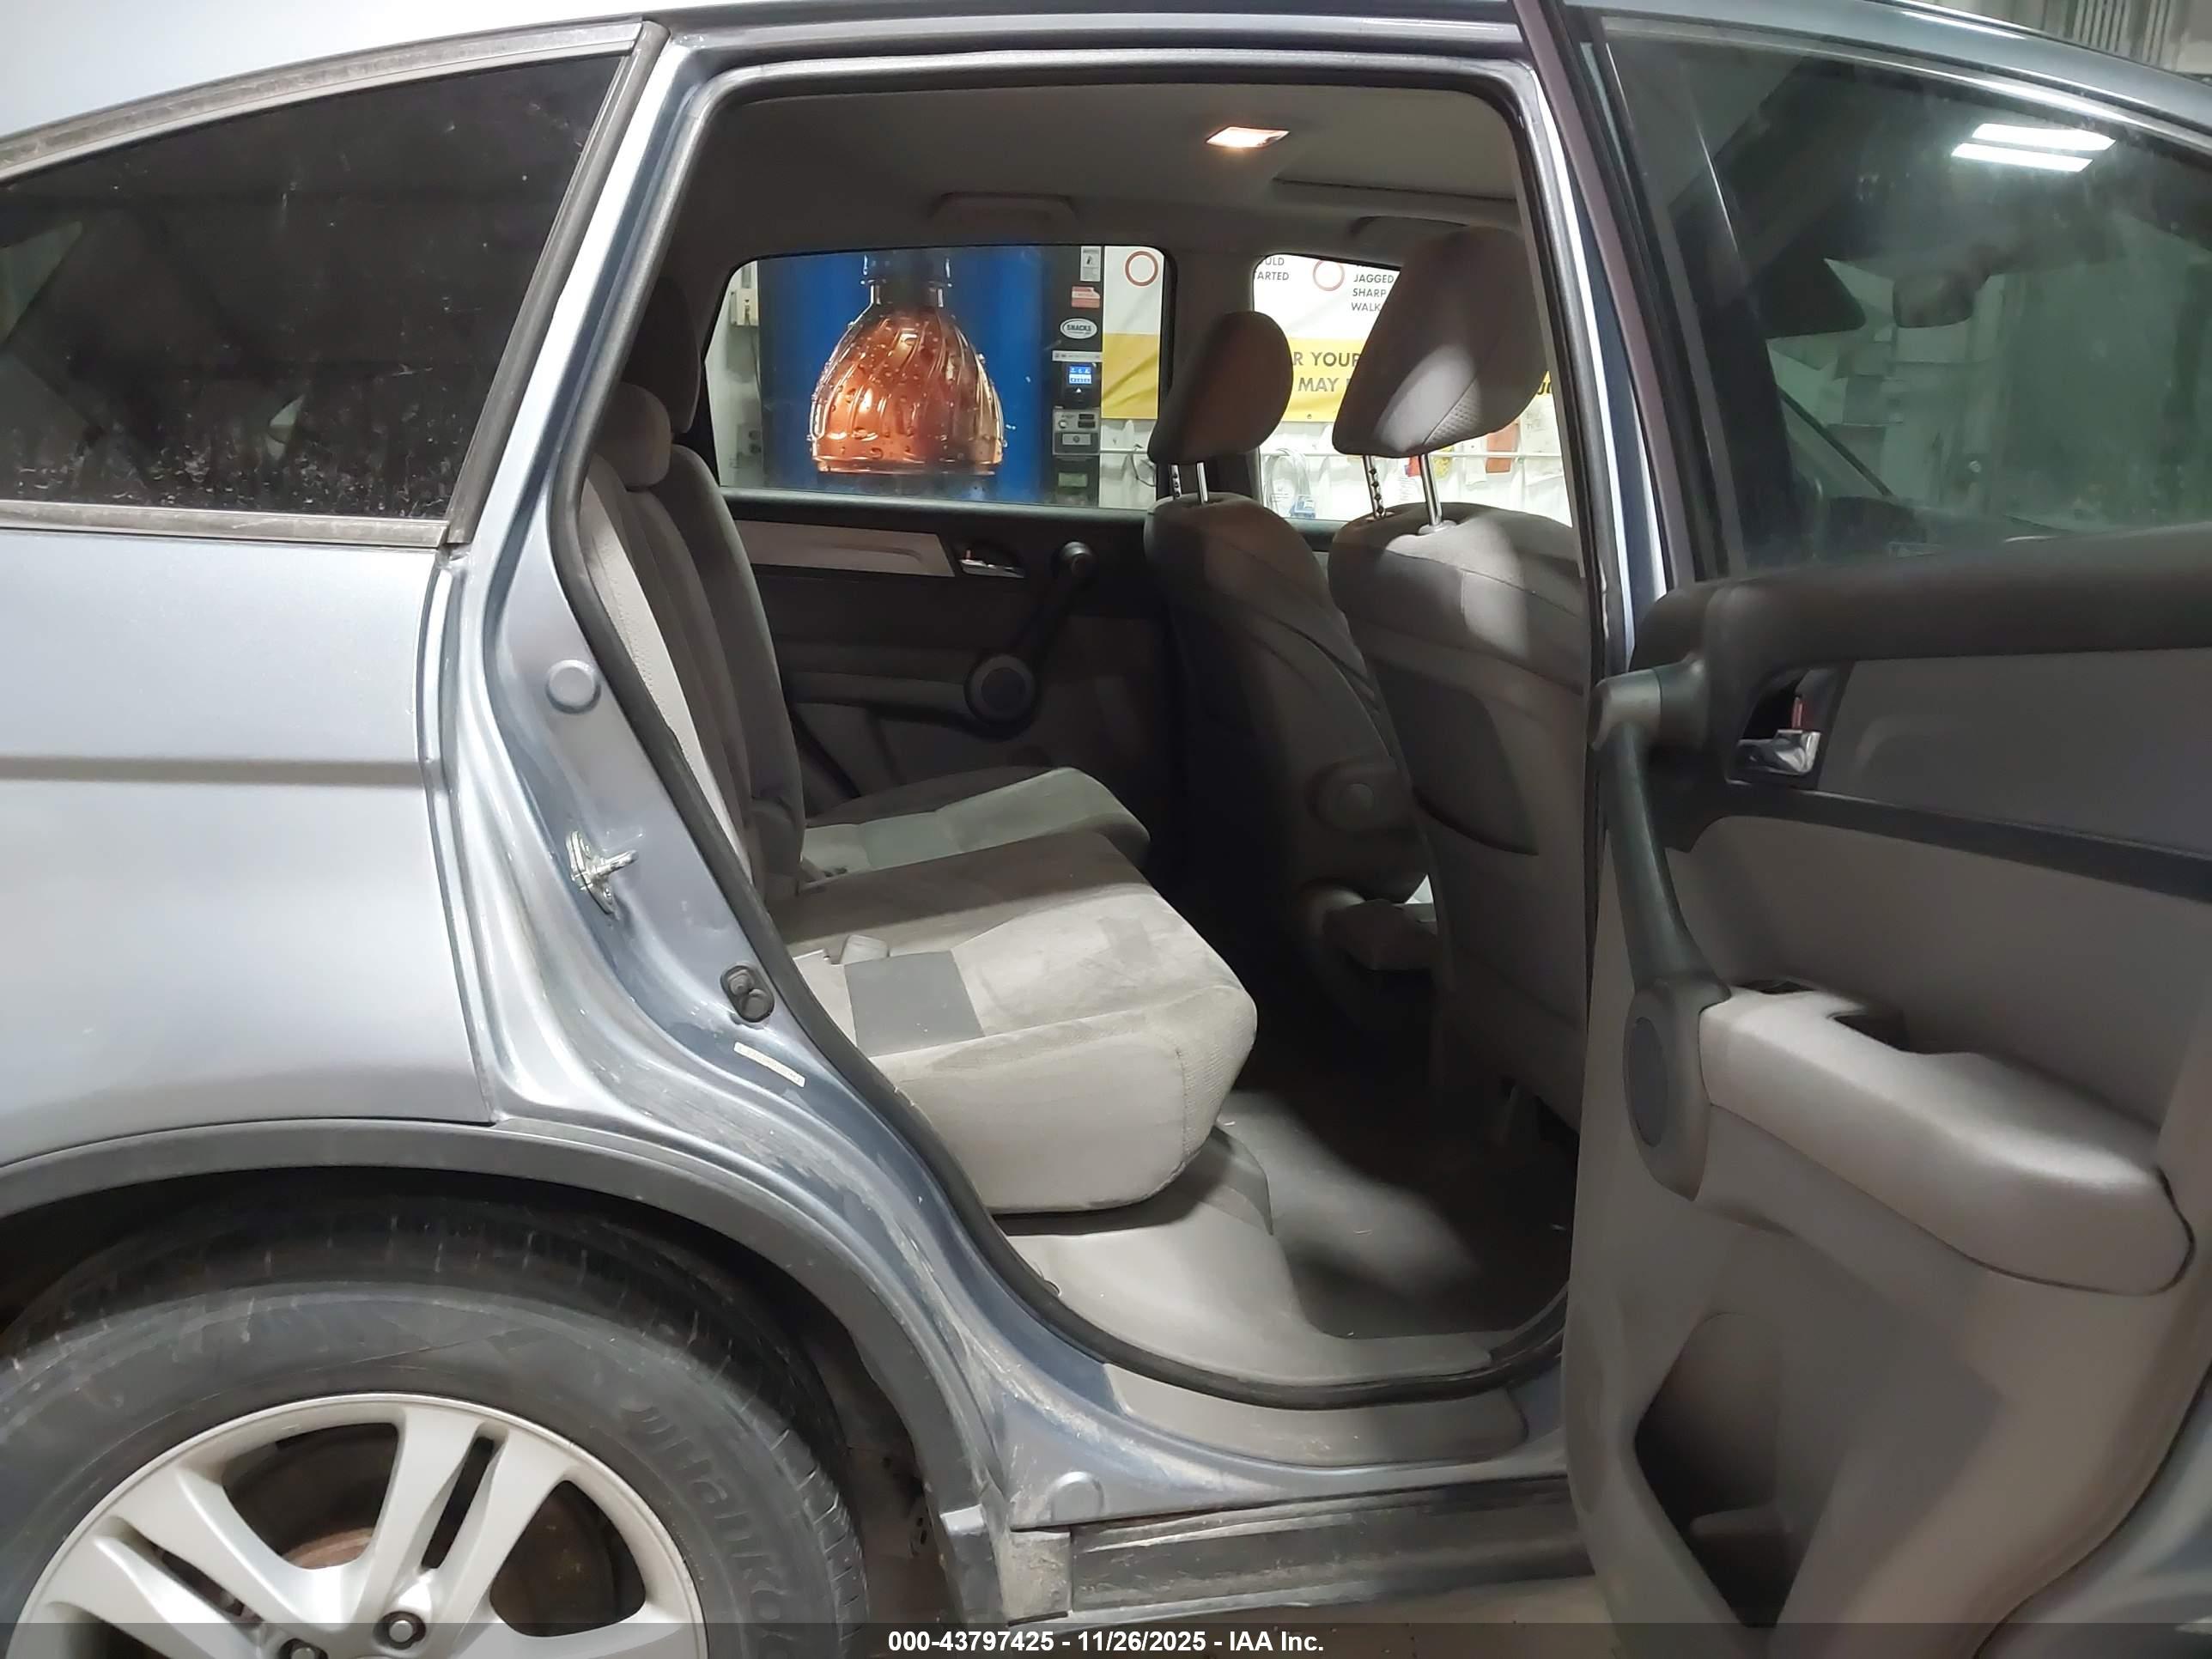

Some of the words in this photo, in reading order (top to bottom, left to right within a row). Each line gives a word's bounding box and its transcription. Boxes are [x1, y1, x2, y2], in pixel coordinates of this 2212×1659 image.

[1255, 271, 1290, 281] ARTED
[1353, 274, 1395, 283] JAGGED
[1352, 288, 1387, 297] SHARP
[1351, 302, 1381, 312] WALK
[1297, 377, 1340, 392] MAY
